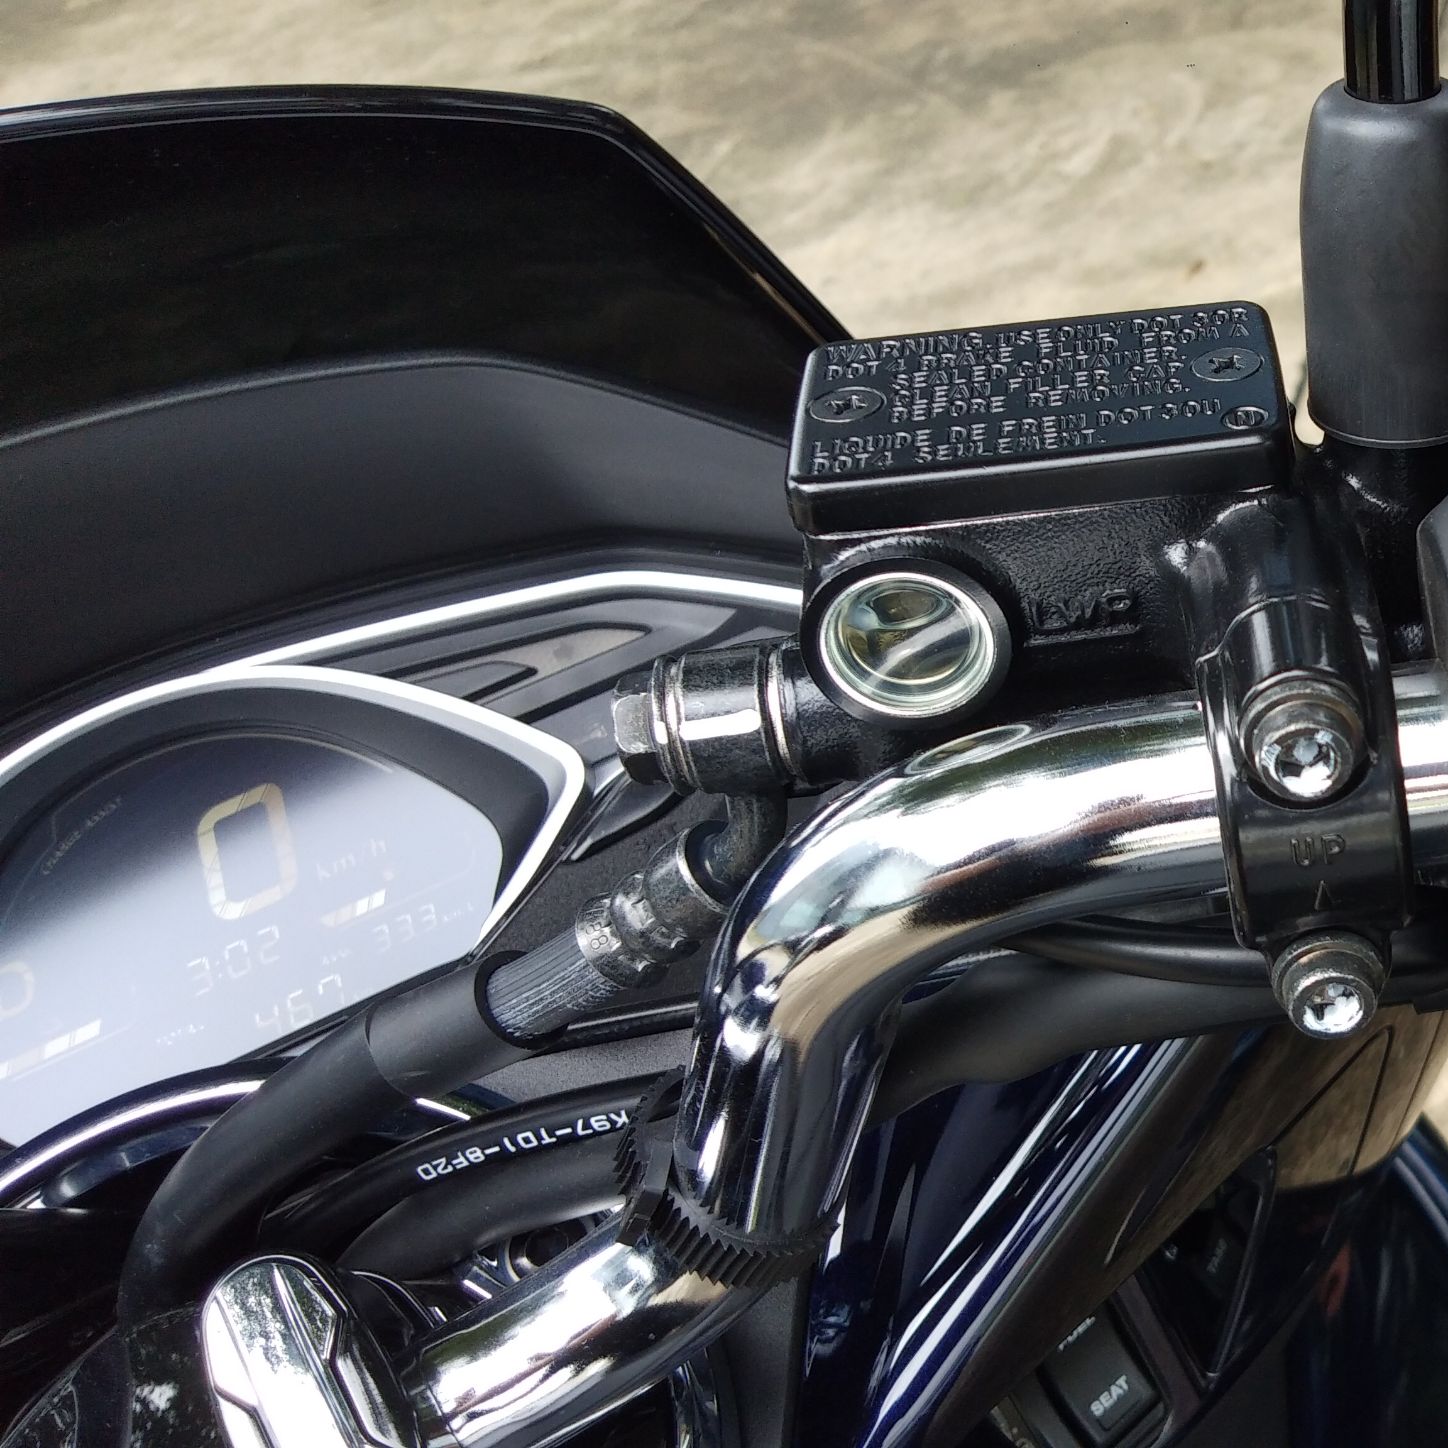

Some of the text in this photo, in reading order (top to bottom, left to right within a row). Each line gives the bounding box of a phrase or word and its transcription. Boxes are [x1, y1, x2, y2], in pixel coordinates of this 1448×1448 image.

[826, 359, 882, 381] DOT
[918, 347, 1015, 371] BRAKE
[1038, 335, 1119, 358] FLUID
[1140, 326, 1221, 349] FROM
[1229, 323, 1250, 338] A
[995, 327, 1052, 347] USE
[1055, 320, 1126, 342] ONLY
[1130, 313, 1184, 335] DOT
[890, 363, 1009, 390] SEALED
[891, 361, 1185, 405] CLEAN FILLER CAP
[812, 428, 933, 457] LIQUIDE
[948, 422, 989, 442] DE
[1001, 411, 1088, 435] FREIN
[1096, 405, 1156, 427] DOT
[890, 396, 1007, 423] BEFORE
[195, 781, 299, 921] 0
[315, 836, 389, 883] km/h
[1289, 832, 1346, 867] UP
[370, 902, 439, 954] 333
[186, 922, 282, 998] 3:02
[1089, 1374, 1130, 1418] SEAT
